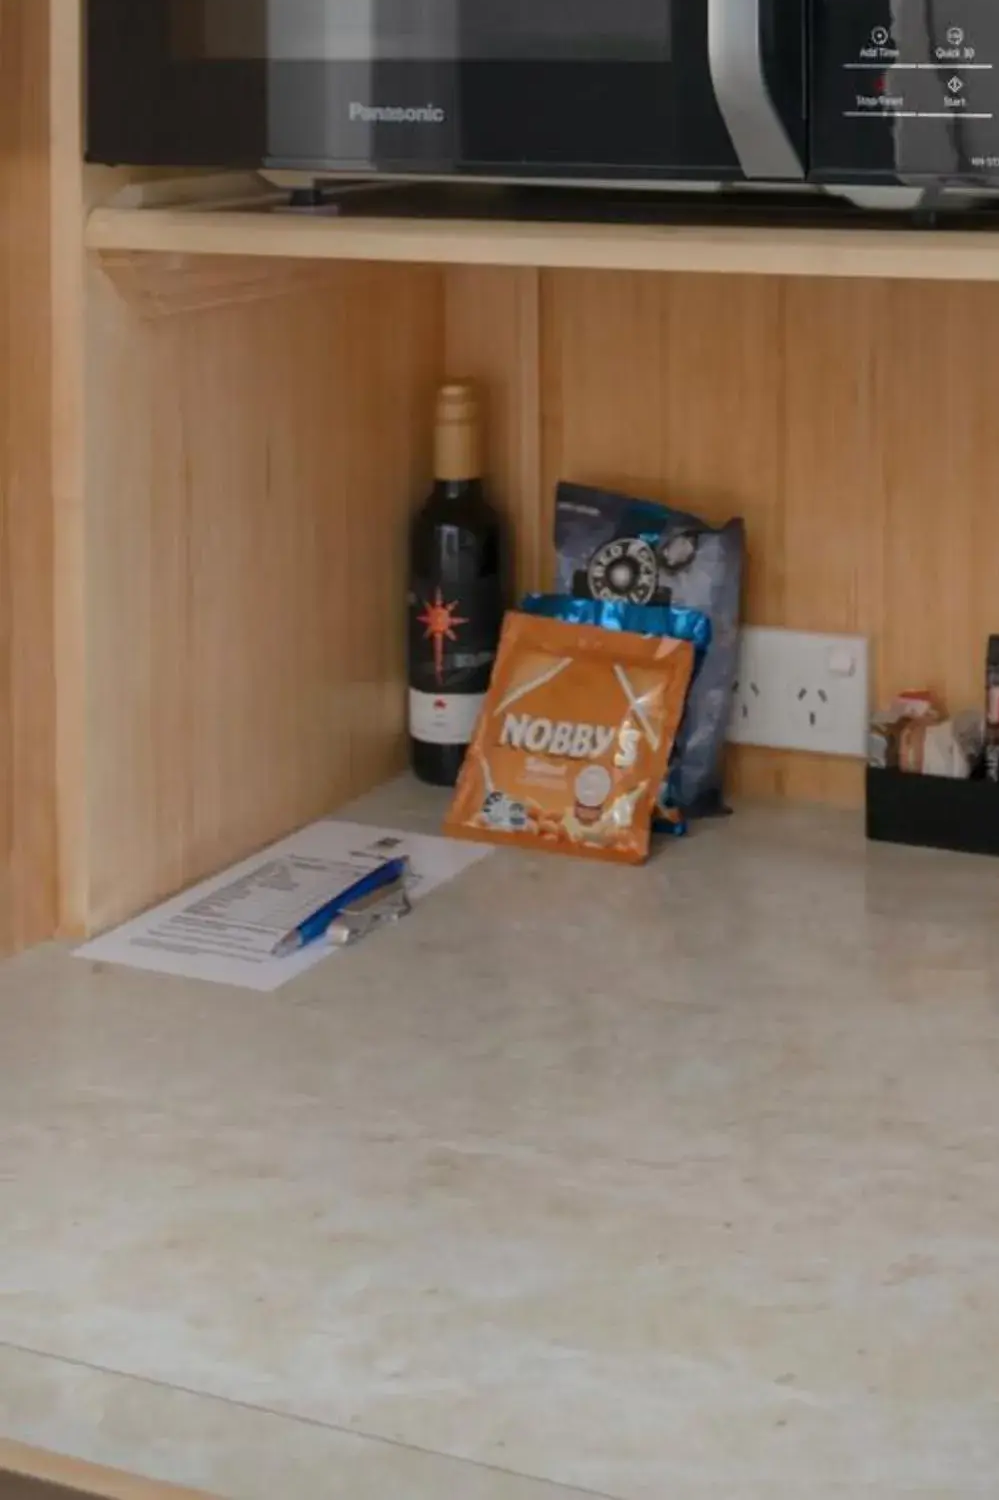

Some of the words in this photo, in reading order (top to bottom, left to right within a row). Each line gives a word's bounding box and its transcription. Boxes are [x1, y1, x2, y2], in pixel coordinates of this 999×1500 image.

[860, 47, 878, 58] Add
[935, 47, 960, 59] Quick
[943, 96, 966, 107] Start
[349, 102, 445, 122] Panasonic
[500, 713, 641, 767] NOBBY'S
